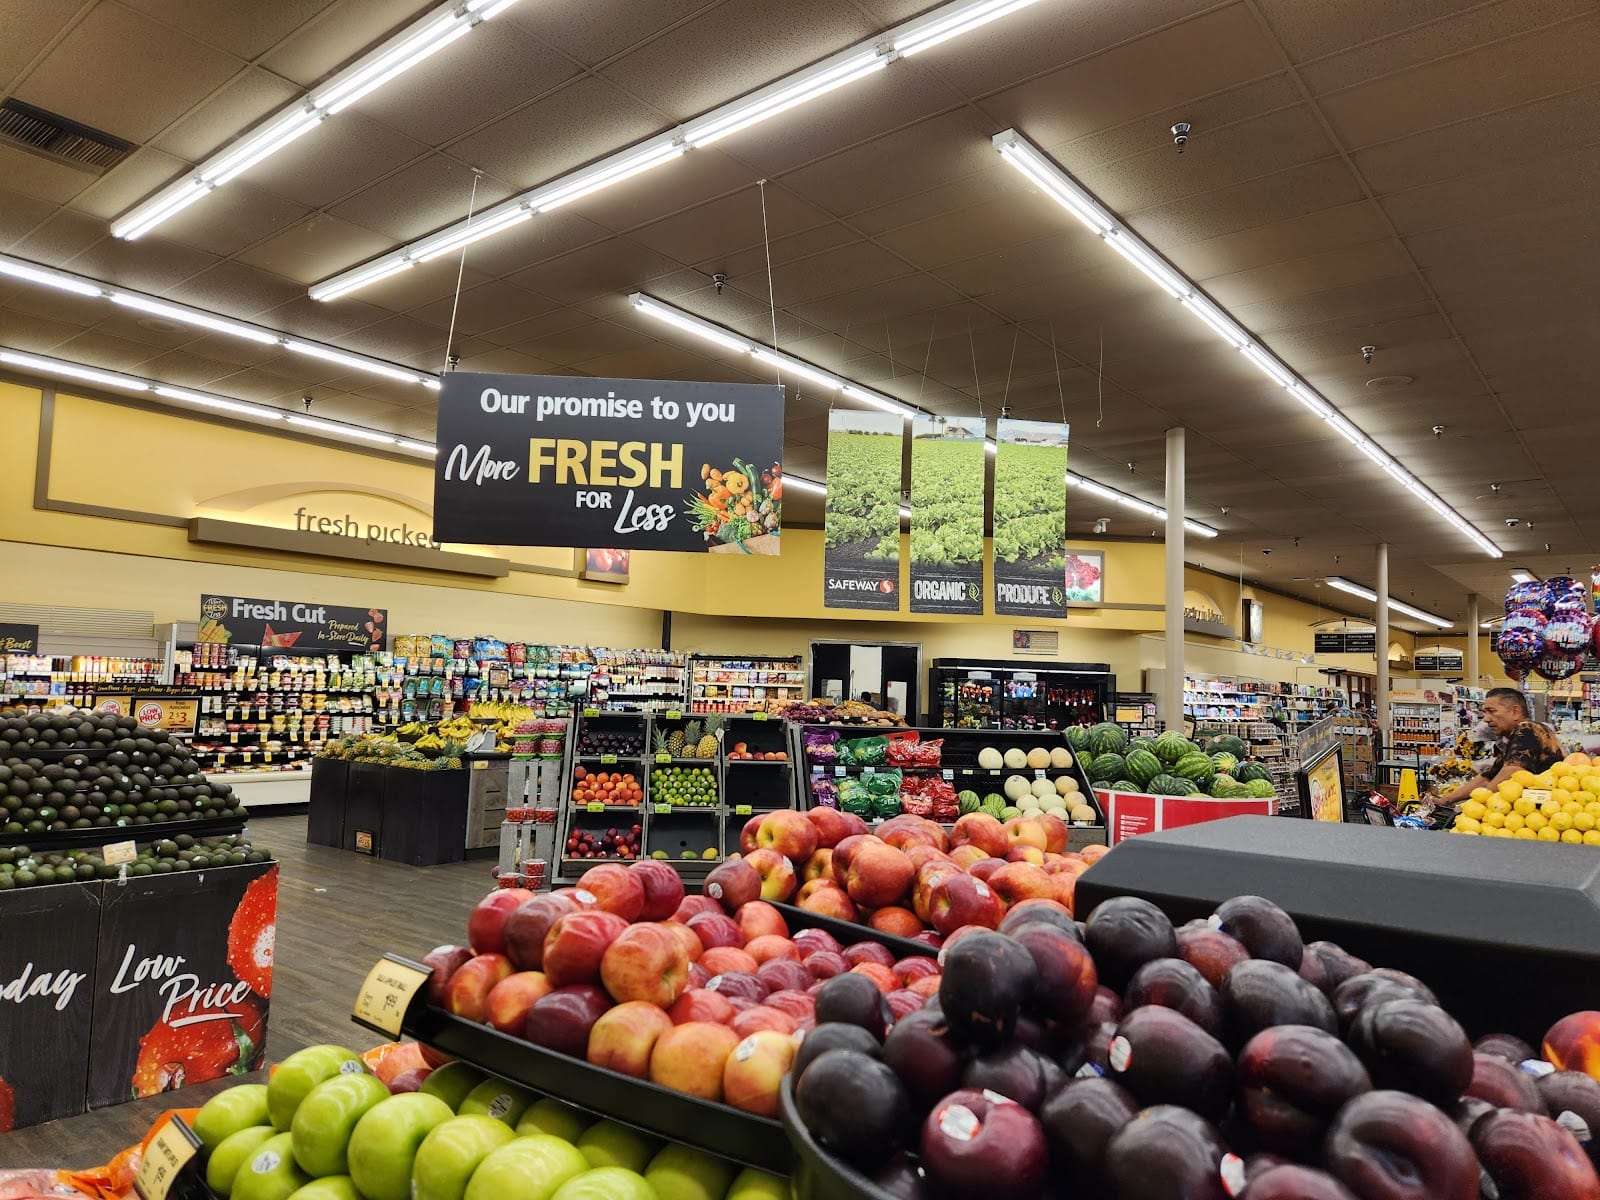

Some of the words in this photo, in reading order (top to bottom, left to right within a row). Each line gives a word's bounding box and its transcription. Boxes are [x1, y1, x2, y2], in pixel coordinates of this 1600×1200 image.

[481, 388, 528, 414] Our
[536, 391, 643, 421] promise
[651, 396, 679, 420] to
[686, 401, 735, 428] you
[444, 443, 519, 486] More
[528, 437, 684, 489] FRESH
[294, 507, 359, 538] fresh
[575, 491, 612, 509] FOR
[613, 489, 676, 534] Less
[828, 578, 879, 592] SAFEWAY
[914, 579, 966, 601] ORGANIC
[997, 582, 1050, 605] PRODUCE
[232, 598, 287, 622] Fresh
[292, 603, 326, 624] Cut
[328, 619, 360, 631] Prepared
[346, 631, 369, 645] Daily
[139, 713, 162, 722] PRICE
[143, 707, 159, 715] LOW
[110, 944, 186, 994] Low
[158, 973, 252, 1024] Price
